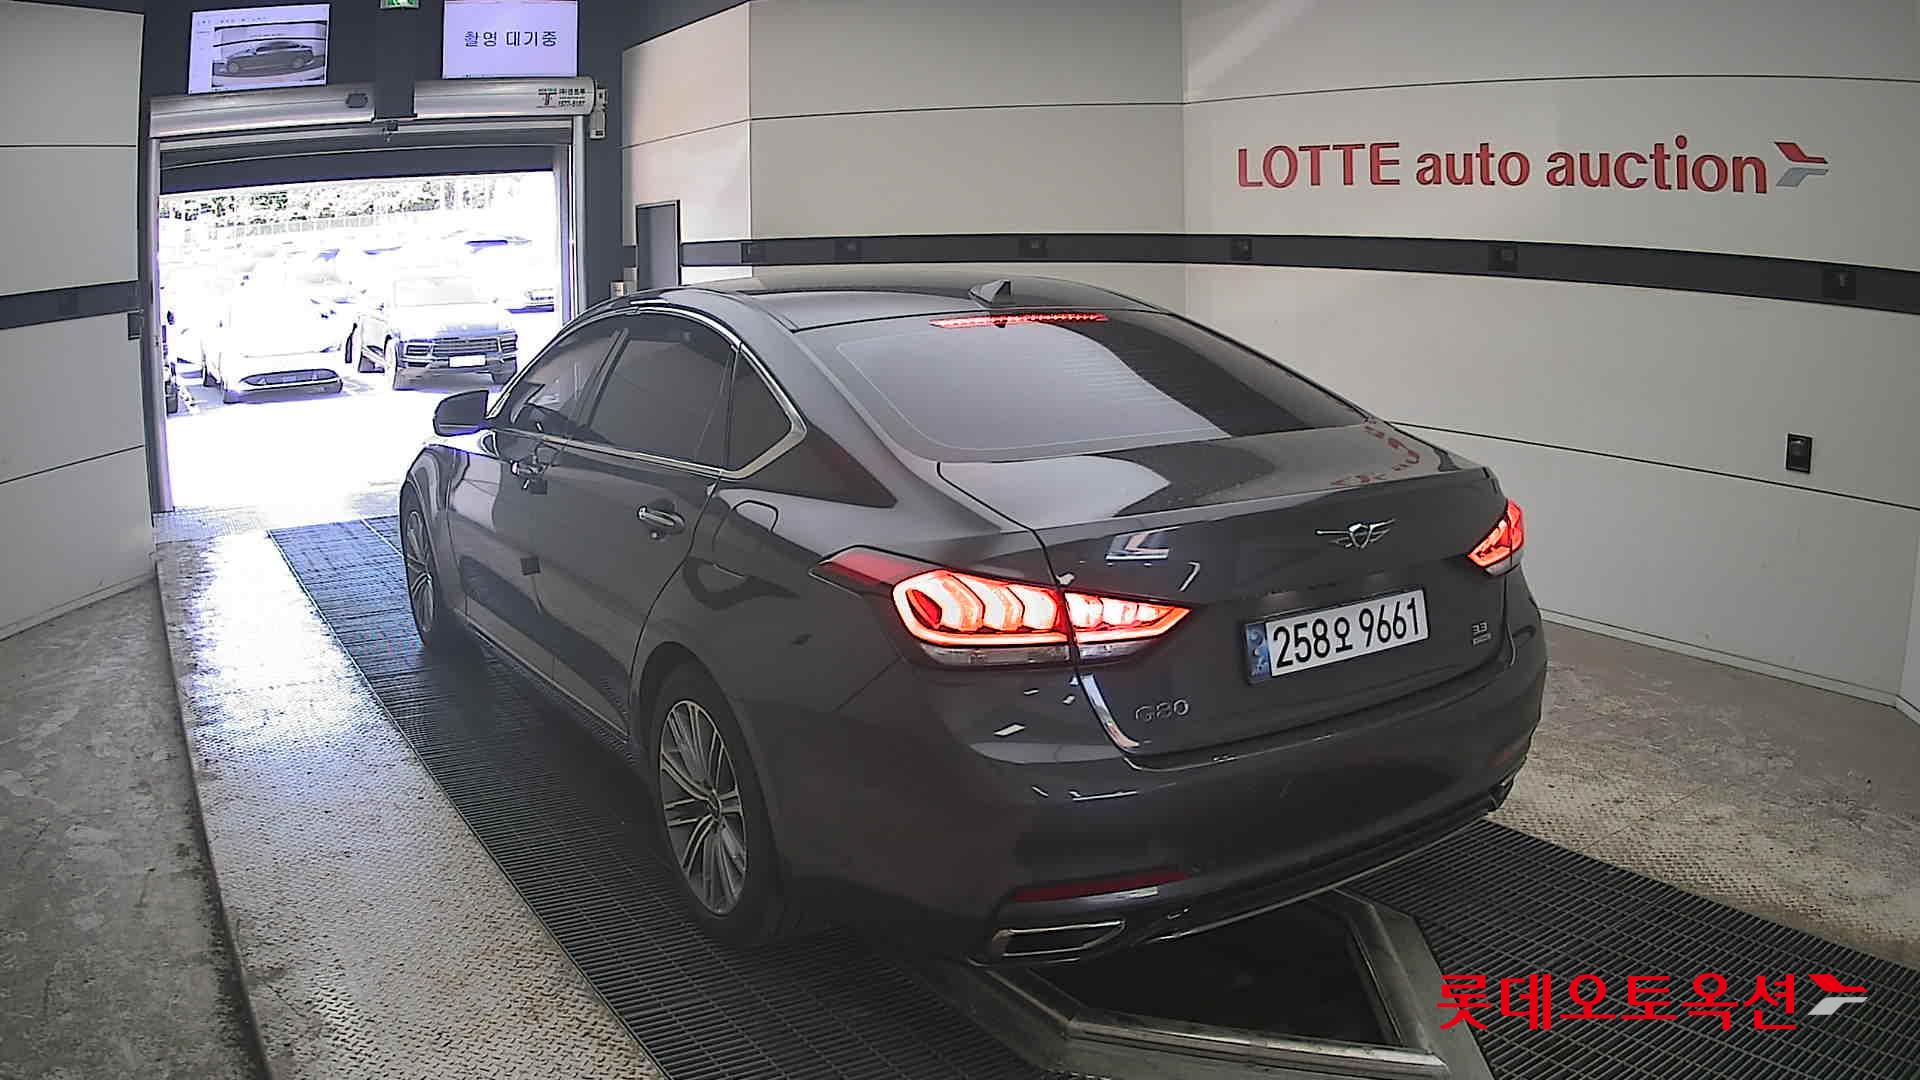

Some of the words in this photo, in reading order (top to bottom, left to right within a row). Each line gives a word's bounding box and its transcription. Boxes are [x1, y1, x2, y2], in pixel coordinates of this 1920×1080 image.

[464, 31, 497, 48] 촬영
[505, 31, 557, 48] 대기중
[1237, 141, 1400, 189] LOTTE
[1415, 142, 1531, 186] auto
[1546, 134, 1768, 194] auction
[1135, 699, 1189, 722] G80
